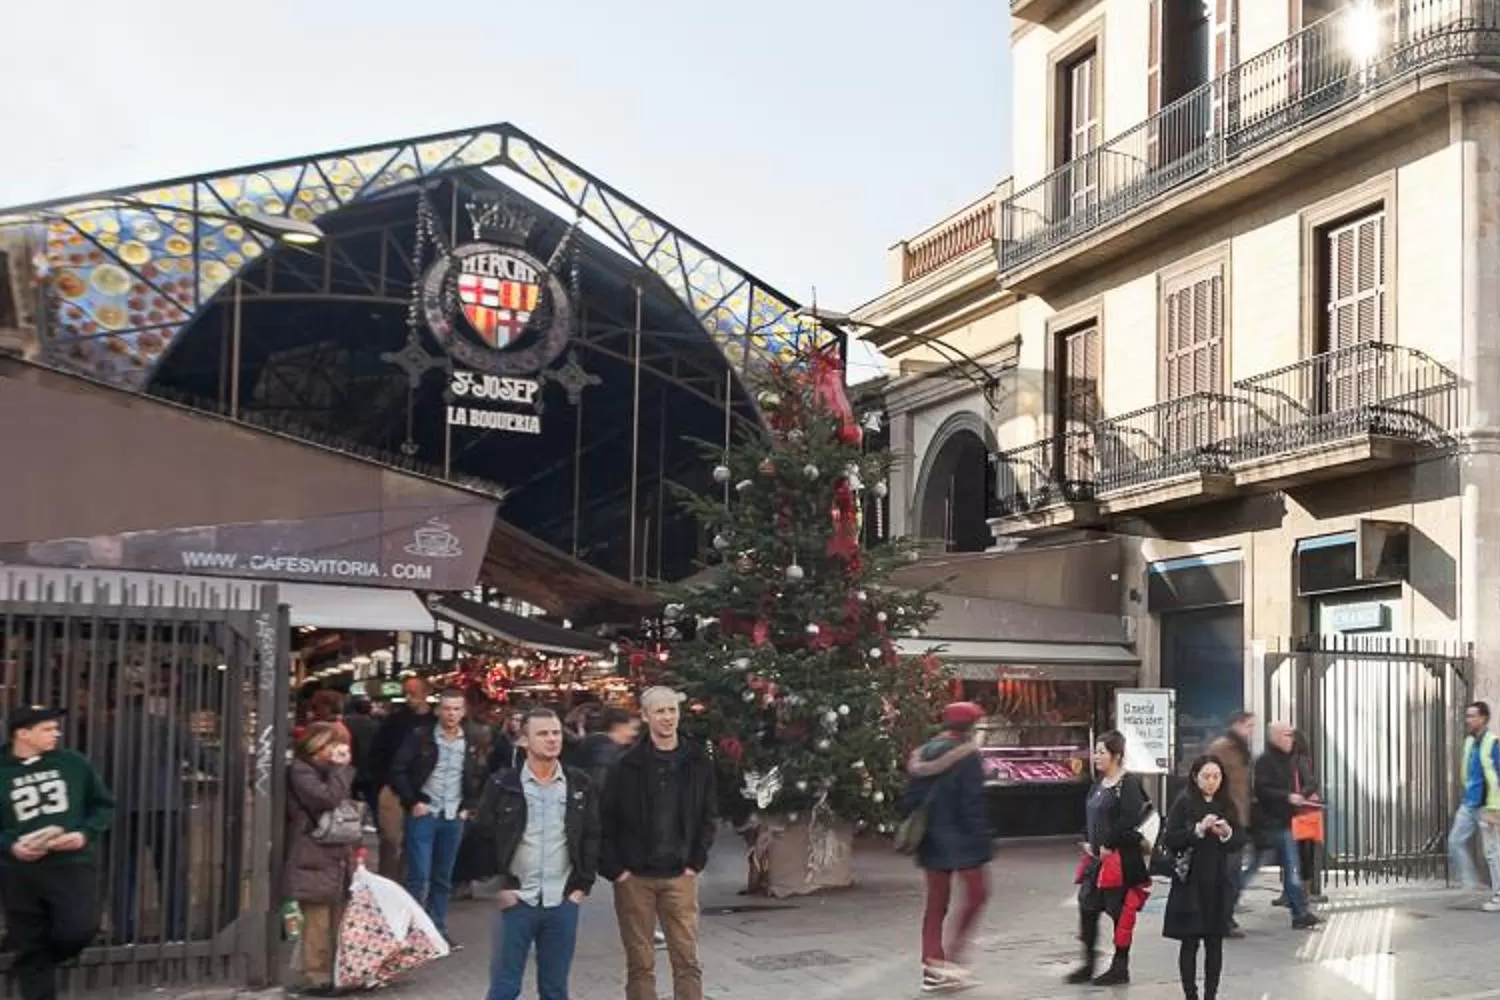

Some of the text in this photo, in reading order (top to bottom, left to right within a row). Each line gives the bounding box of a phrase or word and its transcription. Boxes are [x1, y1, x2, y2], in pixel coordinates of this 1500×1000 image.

[461, 253, 540, 284] MERCAT
[472, 374, 539, 403] JOSEP
[447, 405, 541, 434] LA BOQUERIA
[10, 779, 69, 821] 23
